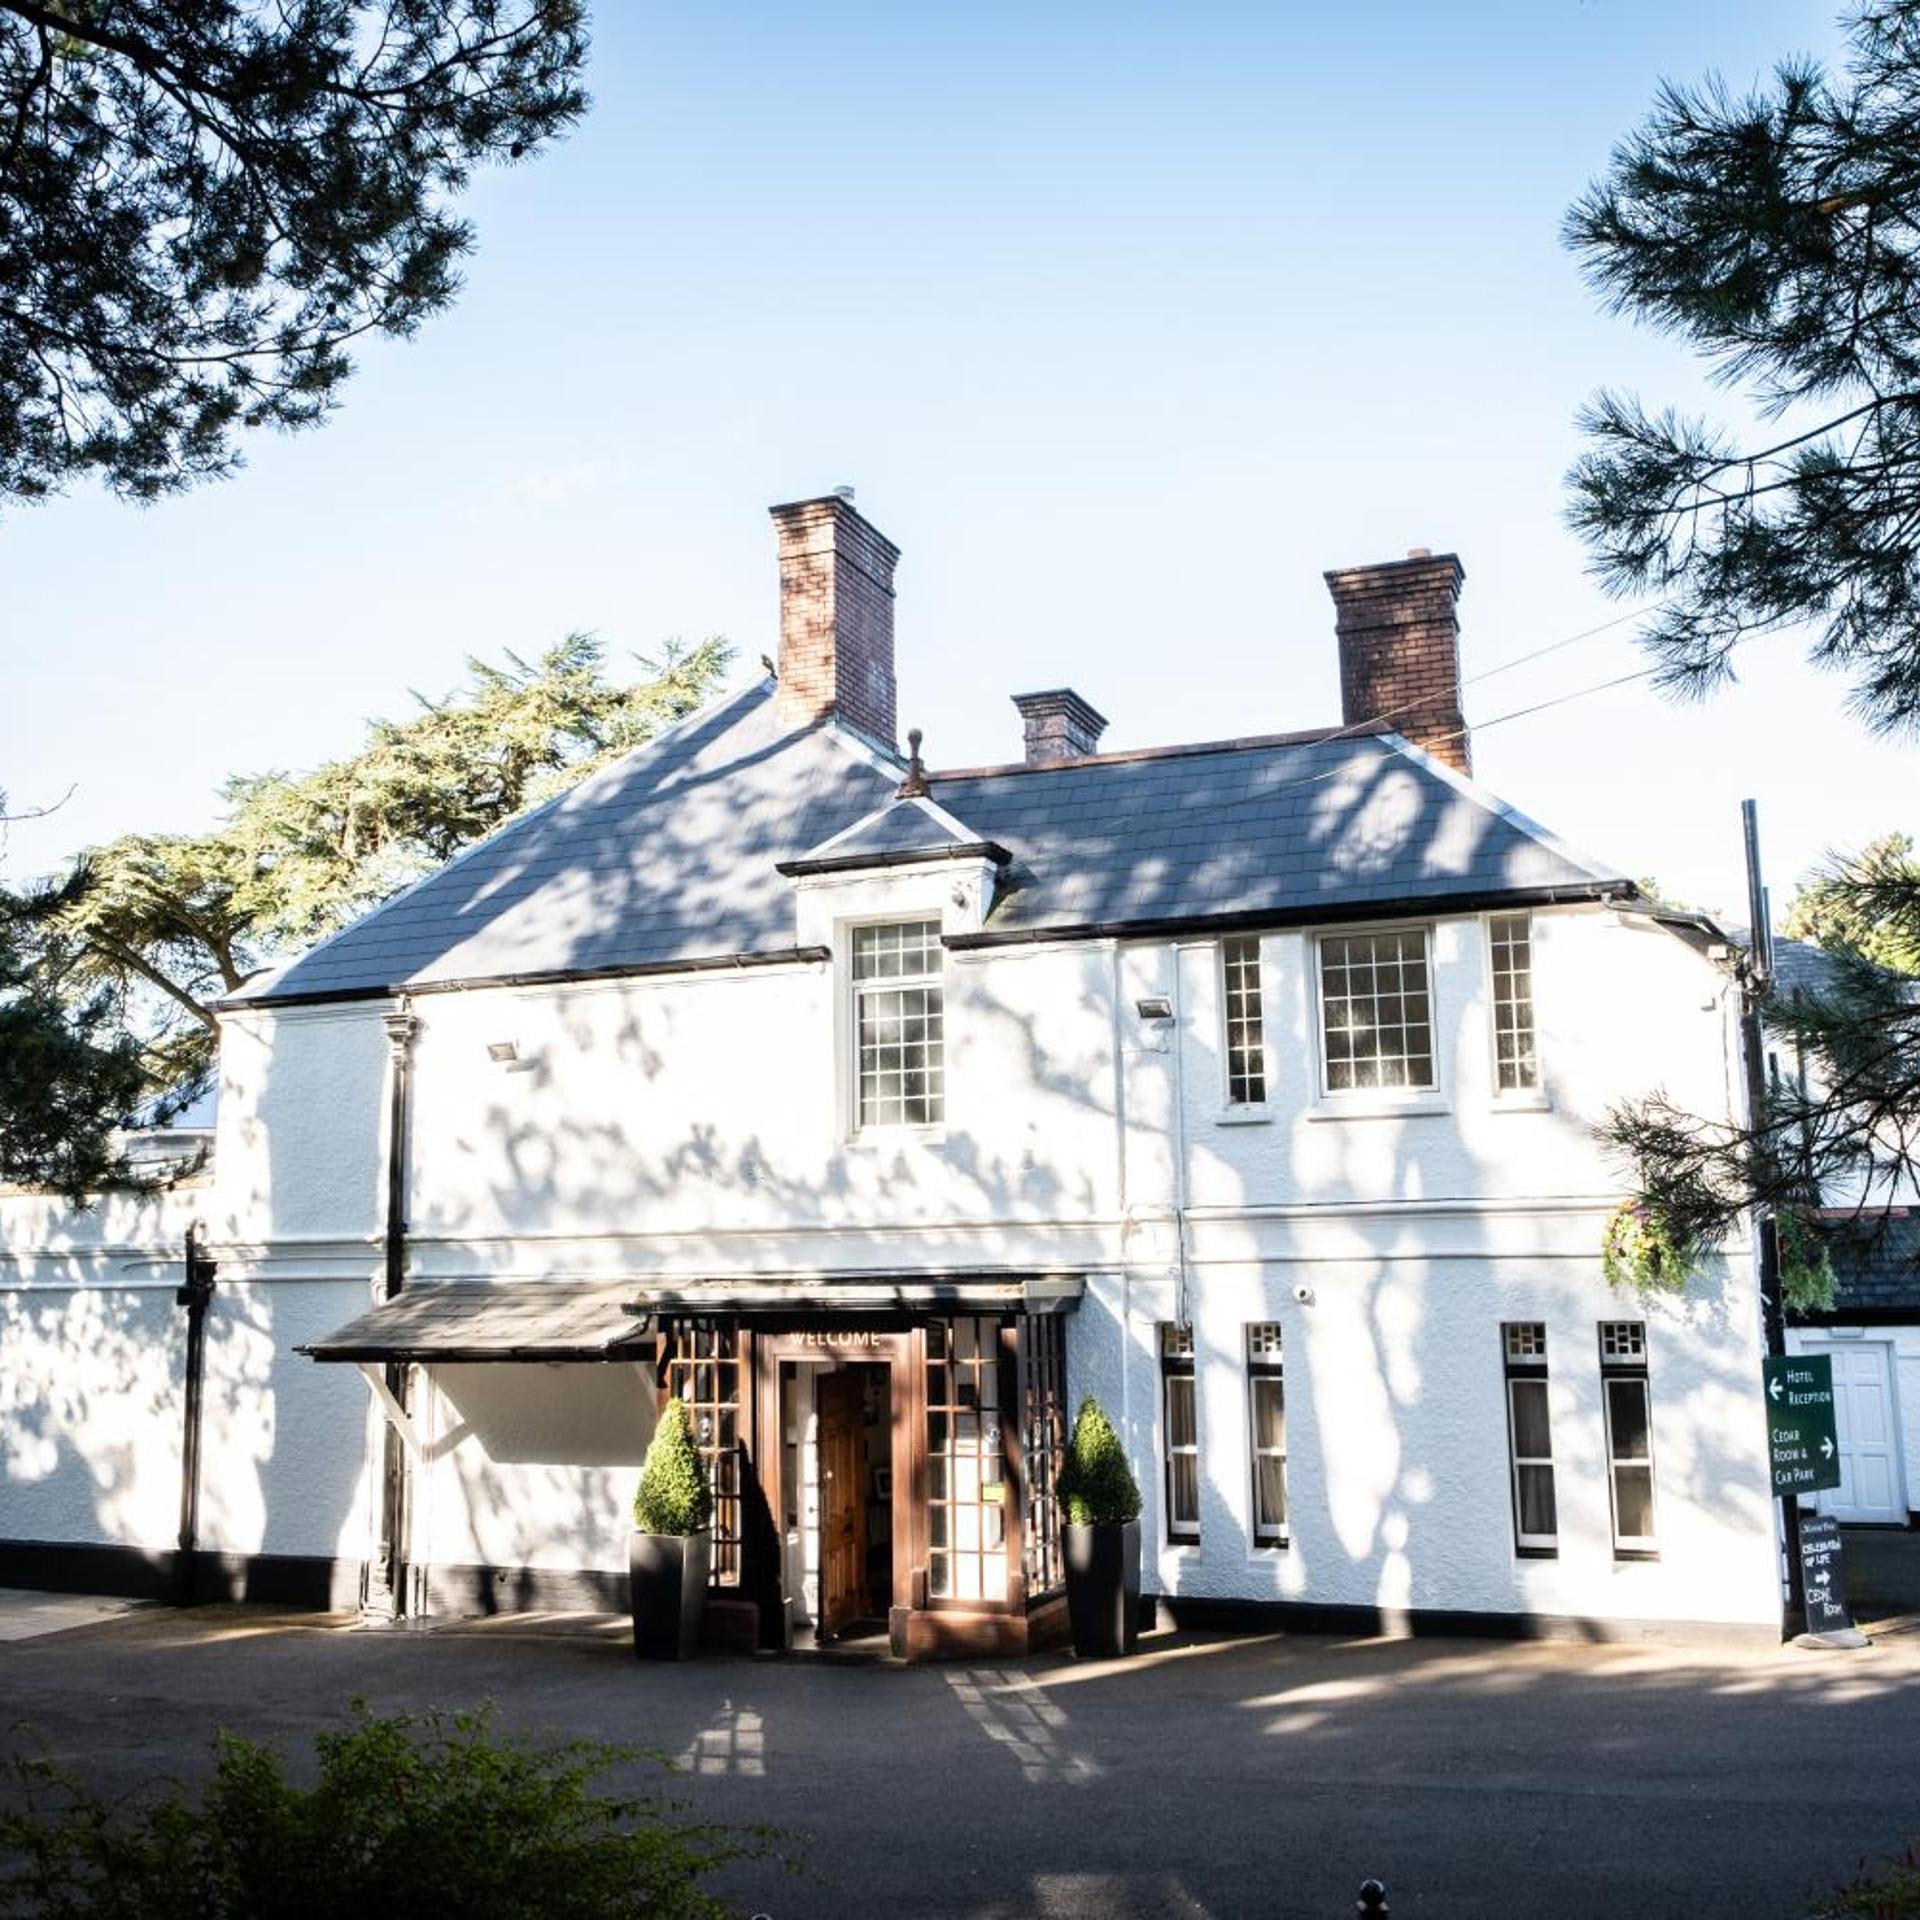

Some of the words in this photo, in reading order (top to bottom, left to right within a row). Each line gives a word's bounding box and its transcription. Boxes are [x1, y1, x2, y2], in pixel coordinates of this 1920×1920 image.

[790, 1332, 880, 1346] WELCOME
[1786, 1370, 1815, 1384] HOTEL
[1788, 1391, 1831, 1405] RECEPTION
[1772, 1428, 1800, 1443] CEDAR
[1773, 1449, 1799, 1462] ROOM
[1775, 1470, 1792, 1485] CAR
[1793, 1468, 1815, 1482] PARK
